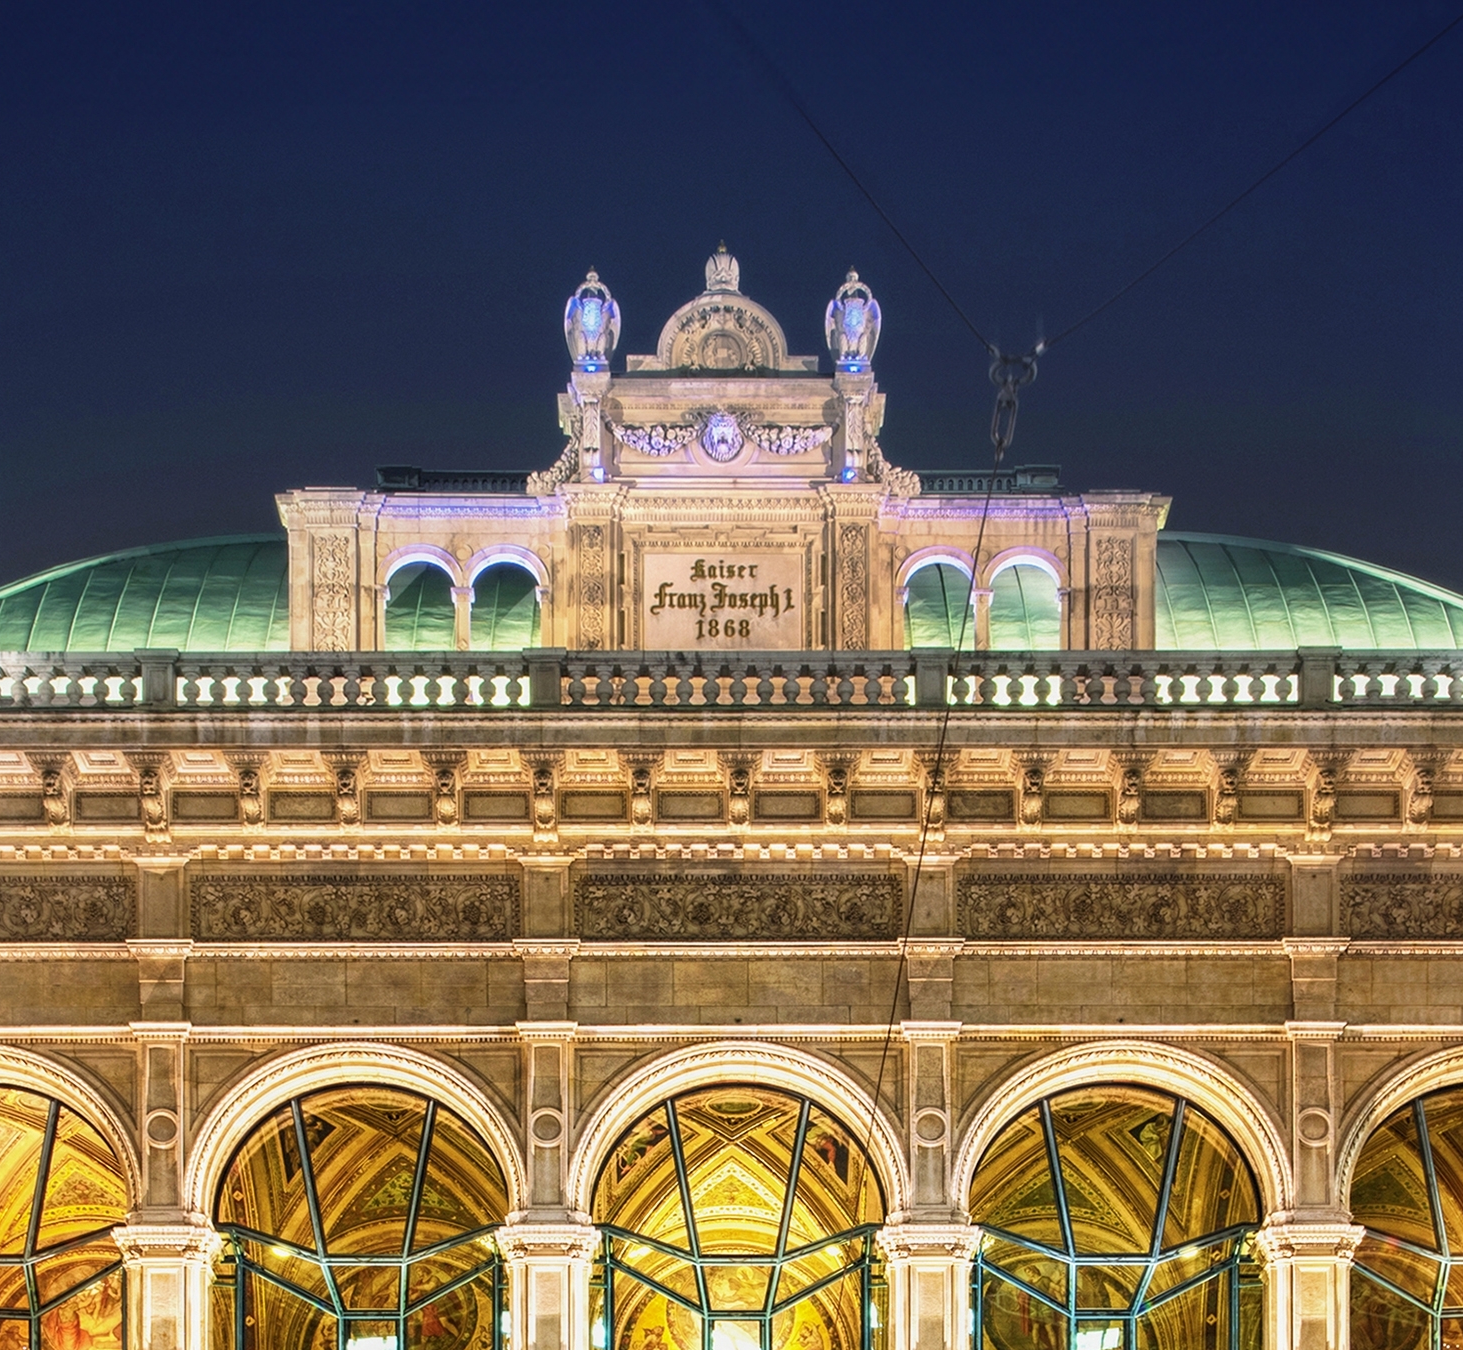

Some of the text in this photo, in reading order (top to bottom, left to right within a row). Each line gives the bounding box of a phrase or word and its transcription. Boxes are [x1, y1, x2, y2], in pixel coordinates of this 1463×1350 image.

[690, 559, 758, 582] Kaiser
[650, 582, 706, 618] Franz
[709, 582, 779, 618] Joseph
[695, 619, 751, 640] 1868
